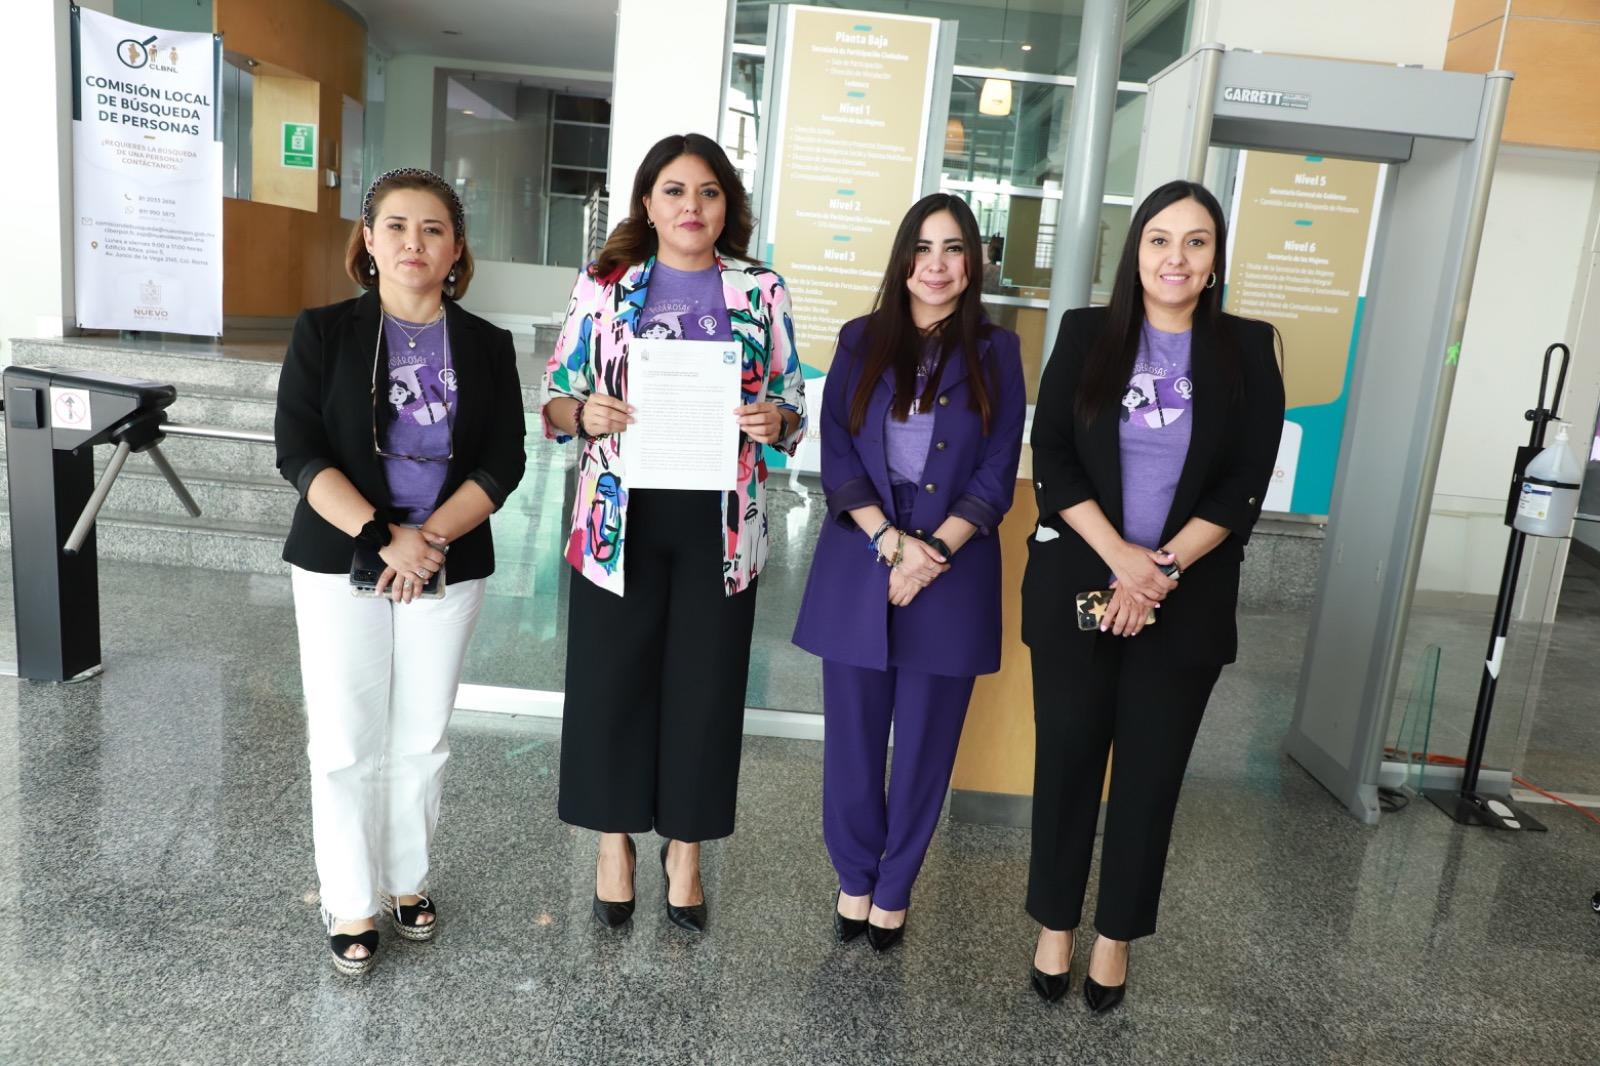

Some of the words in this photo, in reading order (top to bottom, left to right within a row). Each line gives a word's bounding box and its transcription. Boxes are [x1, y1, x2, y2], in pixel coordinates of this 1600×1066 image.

[835, 31, 866, 44] Planta
[868, 34, 888, 48] Baja
[149, 63, 178, 73] CLBNL
[86, 75, 160, 99] COMISIÓN
[165, 90, 210, 106] LOCAL
[1224, 87, 1283, 106] GARRETT
[97, 93, 117, 106] DE
[121, 96, 200, 120] BÚSQUEDA
[839, 103, 864, 115] Nivel
[865, 105, 871, 116] 1
[98, 110, 118, 122] DE
[122, 114, 199, 136] PERSONAS
[1294, 173, 1318, 186] Nivel
[1319, 175, 1327, 186] 5
[828, 198, 853, 210] Nivel
[854, 200, 861, 211] 2
[1283, 240, 1308, 252] Nivel
[1309, 242, 1317, 253] 6
[824, 248, 848, 261] Nivel
[849, 251, 856, 262] 3
[133, 308, 168, 317] NUEVO
